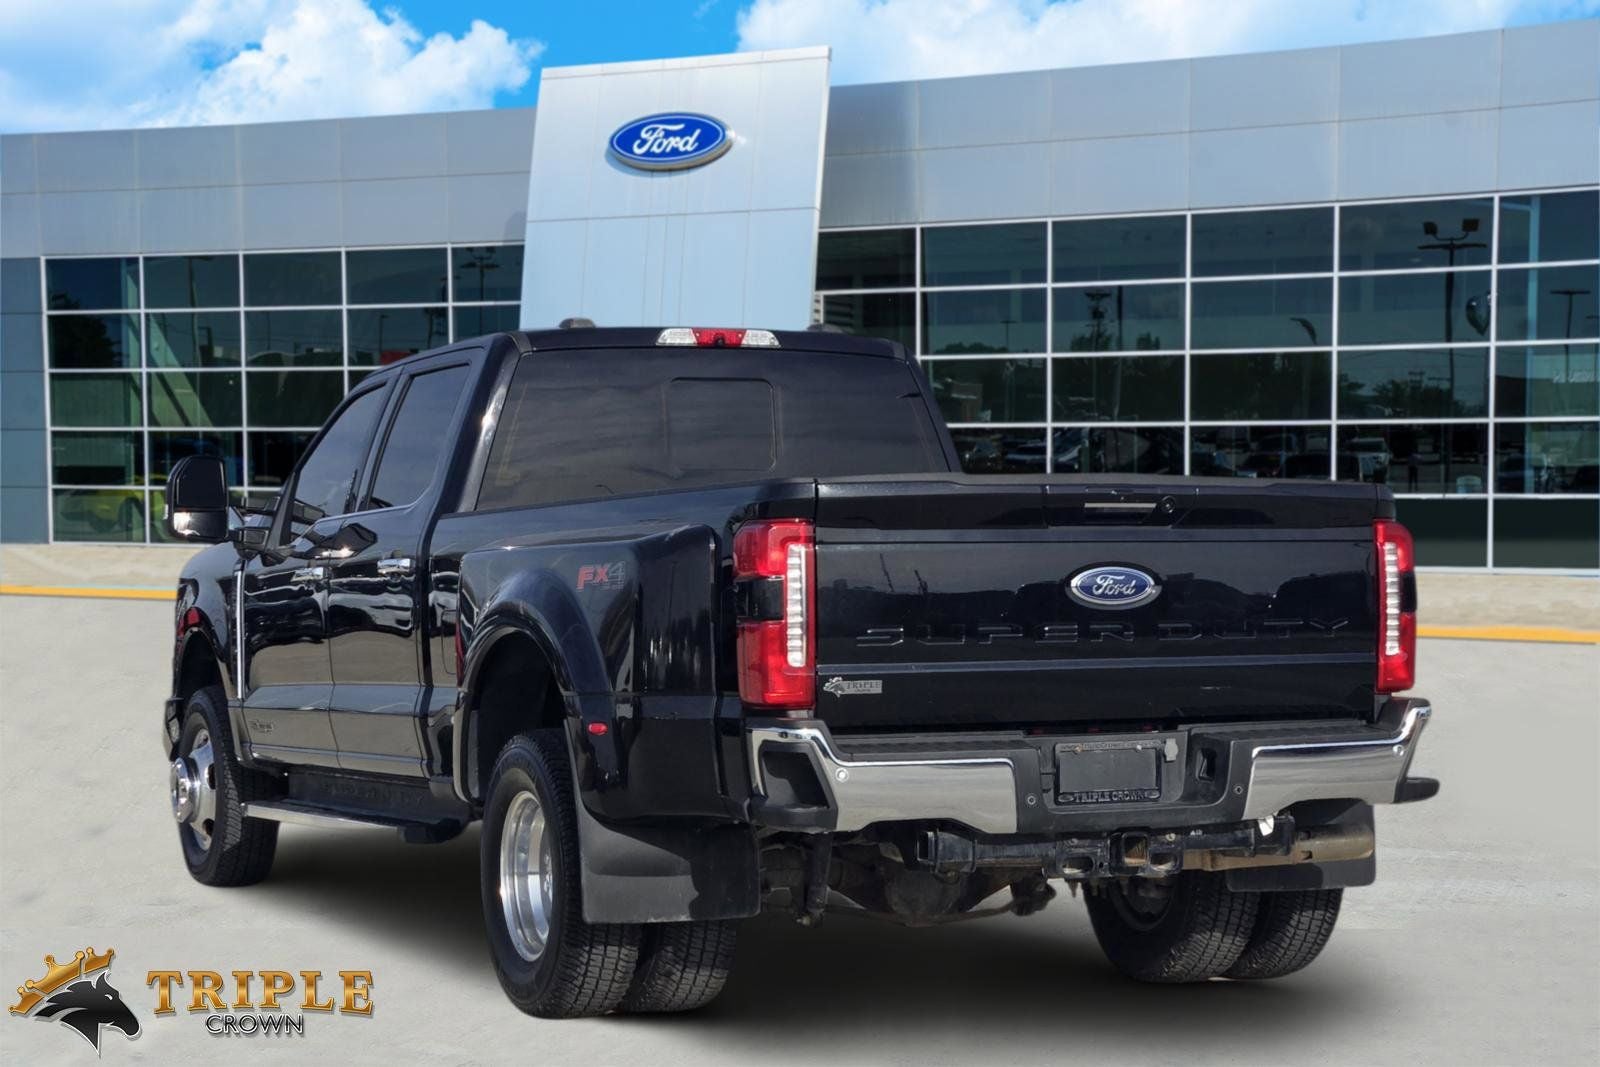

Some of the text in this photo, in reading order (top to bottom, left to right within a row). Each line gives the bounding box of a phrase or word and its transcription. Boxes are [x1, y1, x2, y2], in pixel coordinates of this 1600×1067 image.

[632, 123, 701, 155] Ford
[576, 561, 626, 591] FX4
[1092, 574, 1137, 596] Ford
[856, 617, 1349, 648] SUPER DUTY
[1074, 790, 1145, 803] TRIPLE CROWN
